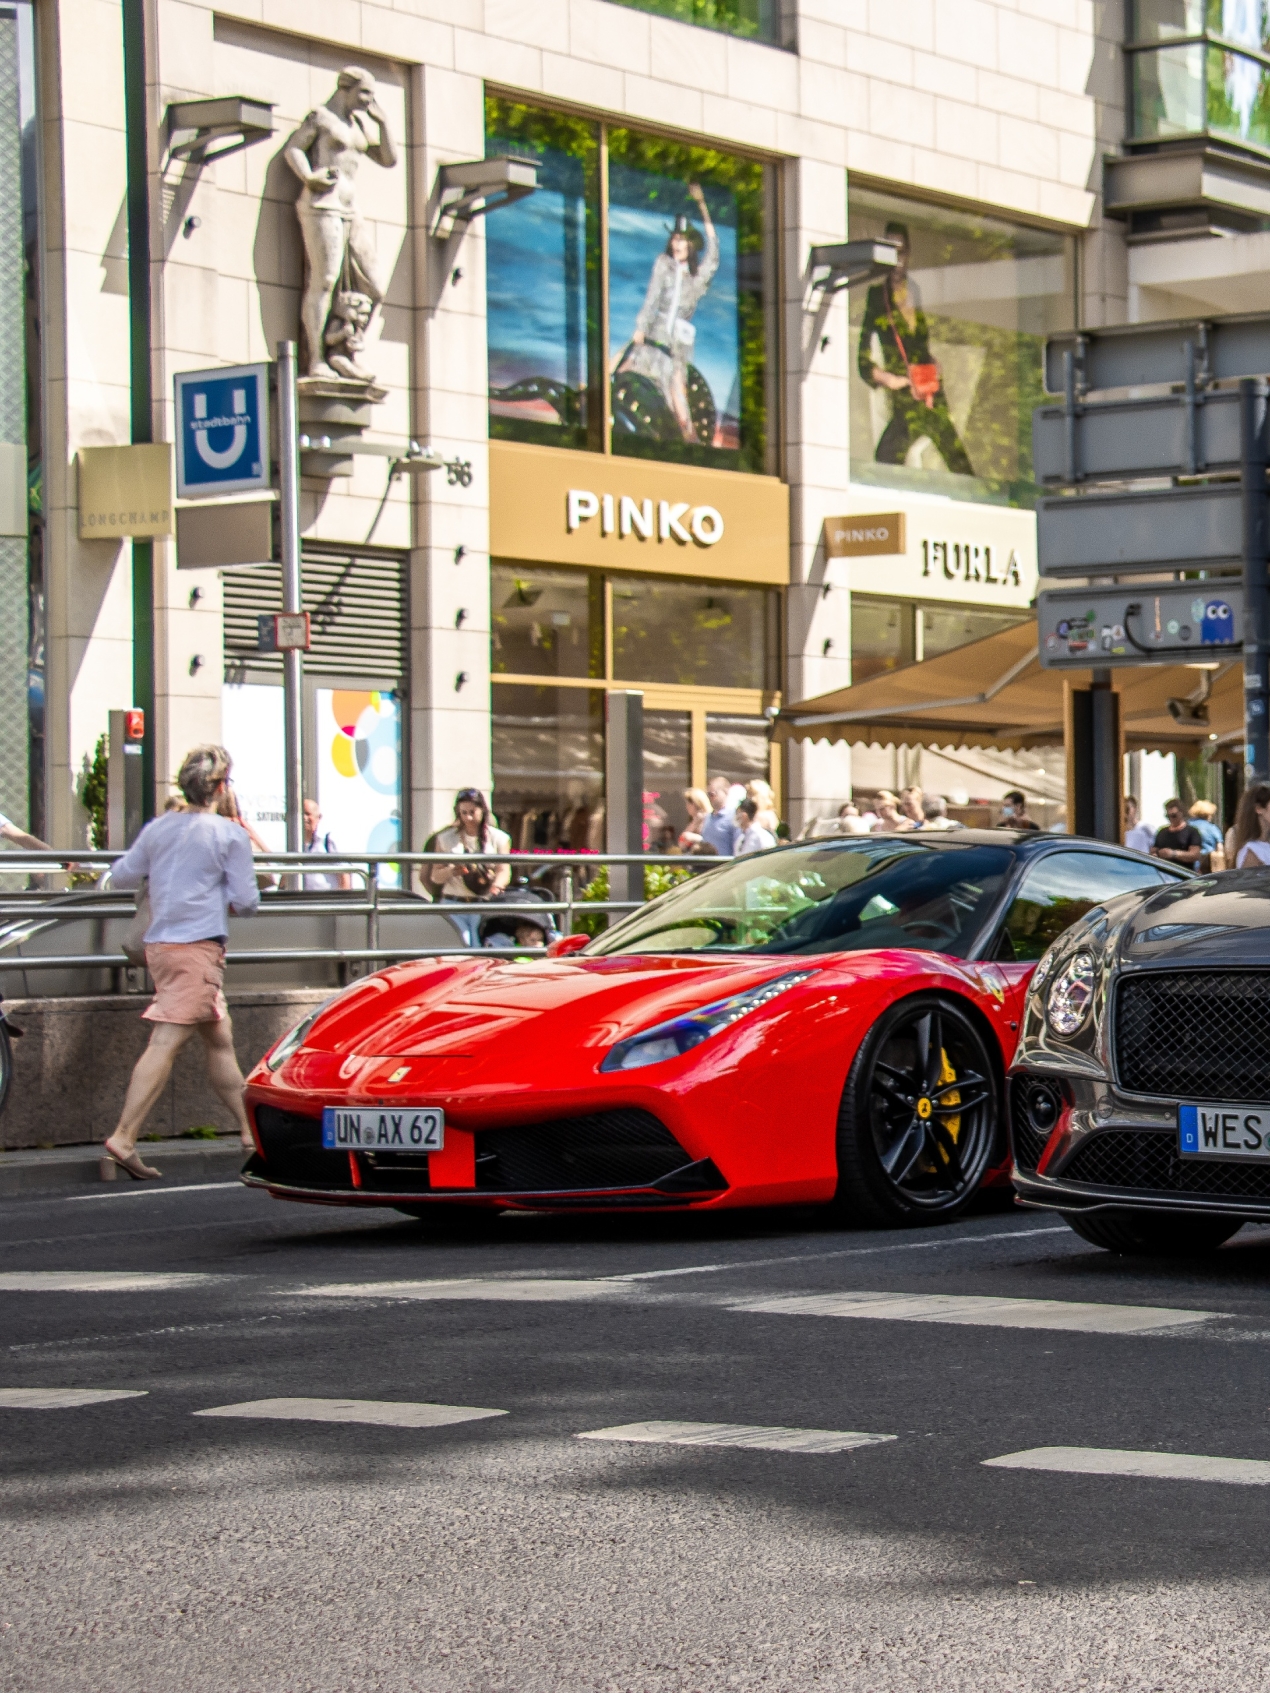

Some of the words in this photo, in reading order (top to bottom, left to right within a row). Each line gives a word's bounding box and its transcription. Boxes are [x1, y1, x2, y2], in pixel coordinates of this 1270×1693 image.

[190, 415, 251, 430] stadtbahn
[80, 509, 169, 528] LONGCHAMP
[566, 489, 724, 548] PINKO
[834, 526, 889, 543] PINKO
[923, 539, 1026, 587] FURLA
[337, 1113, 361, 1143] UN
[377, 1114, 404, 1144] AX
[410, 1114, 437, 1144] 62
[1186, 1133, 1194, 1143] D
[1201, 1112, 1262, 1150] WES
